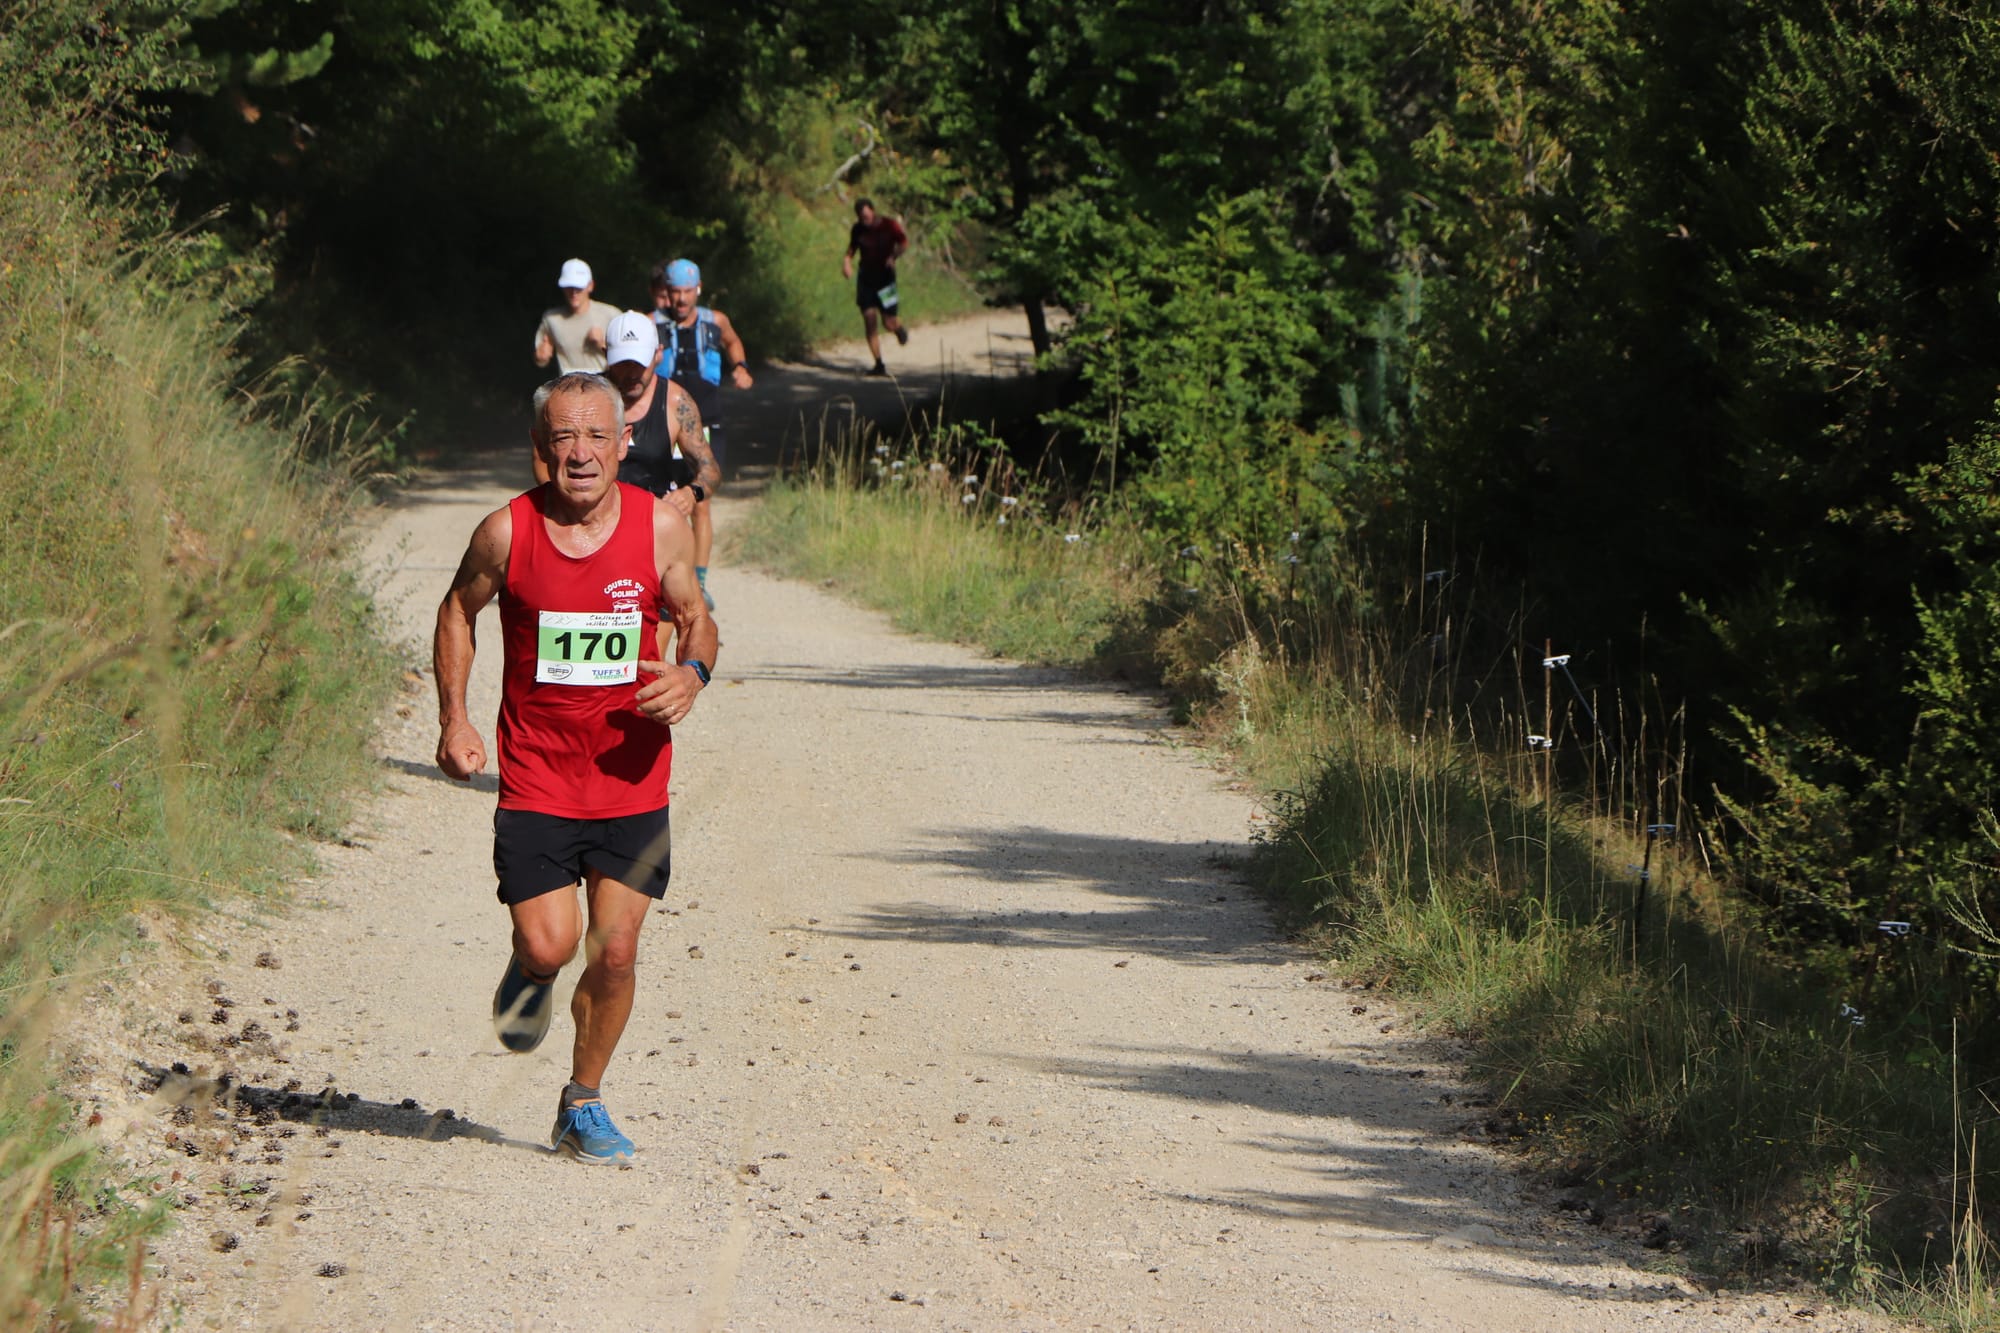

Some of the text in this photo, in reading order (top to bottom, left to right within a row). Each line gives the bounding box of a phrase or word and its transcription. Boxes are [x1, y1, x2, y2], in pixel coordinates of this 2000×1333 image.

[603, 579, 645, 594] COURSE DU
[611, 590, 639, 599] DOLMEN
[554, 631, 627, 661] 170
